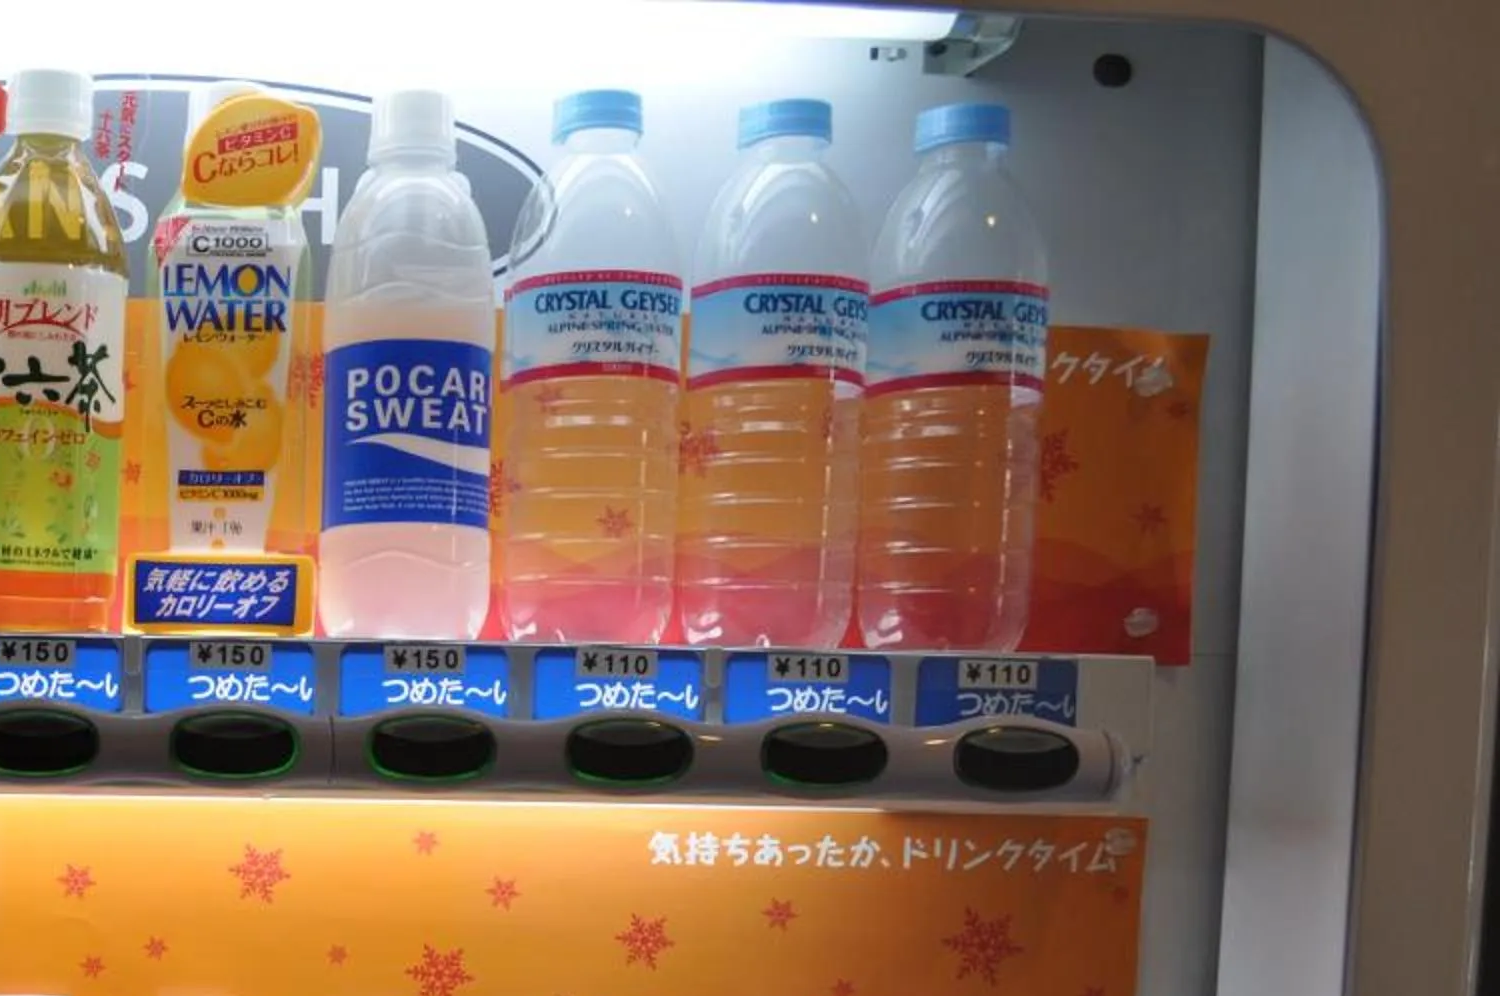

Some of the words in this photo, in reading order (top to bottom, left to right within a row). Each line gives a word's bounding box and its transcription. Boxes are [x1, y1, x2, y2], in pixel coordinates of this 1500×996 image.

[224, 126, 292, 151] ビタミンC
[163, 262, 291, 297] LEMON
[535, 289, 612, 315] CRYSTAL
[743, 292, 822, 316] CRYSTAL
[920, 299, 1006, 322] CRYSTAL
[166, 299, 286, 333] WATER
[197, 409, 247, 429] Cの水
[345, 397, 488, 435] SWEAT
[143, 567, 290, 594] 気軽に飲める
[159, 594, 279, 619] カロリーオフ
[2, 641, 69, 663] ¥150
[197, 643, 265, 666] ¥150
[393, 649, 460, 670] ¥150
[582, 652, 648, 675] ¥110
[775, 657, 842, 678] ¥110
[966, 663, 1031, 685] ¥110
